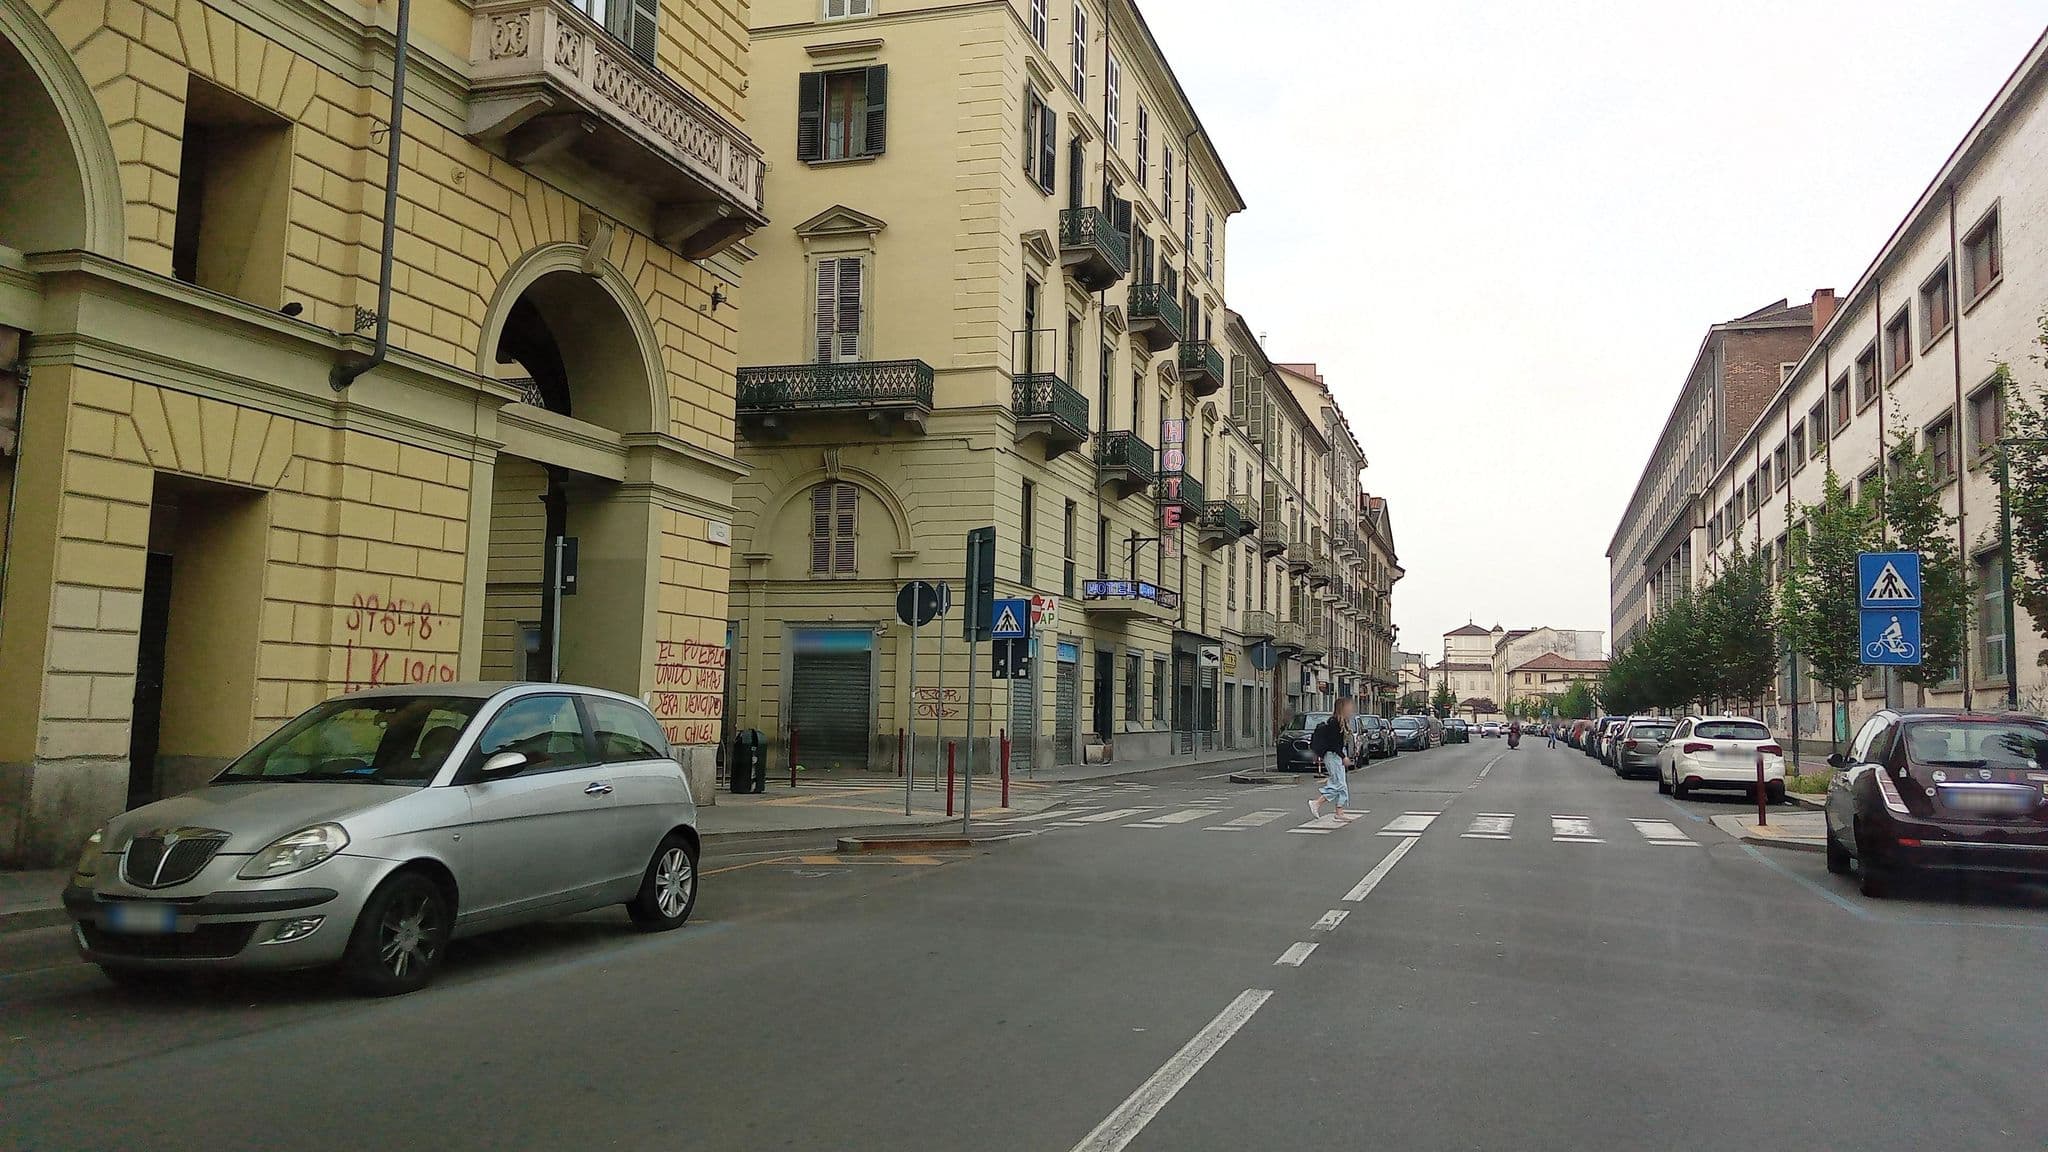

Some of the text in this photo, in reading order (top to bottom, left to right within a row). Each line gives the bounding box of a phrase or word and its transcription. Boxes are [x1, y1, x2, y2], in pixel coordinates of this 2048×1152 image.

[1163, 419, 1184, 558] HOTEL
[1086, 581, 1137, 596] HOTEL
[659, 642, 675, 660] EL
[656, 663, 692, 686] UNIDO
